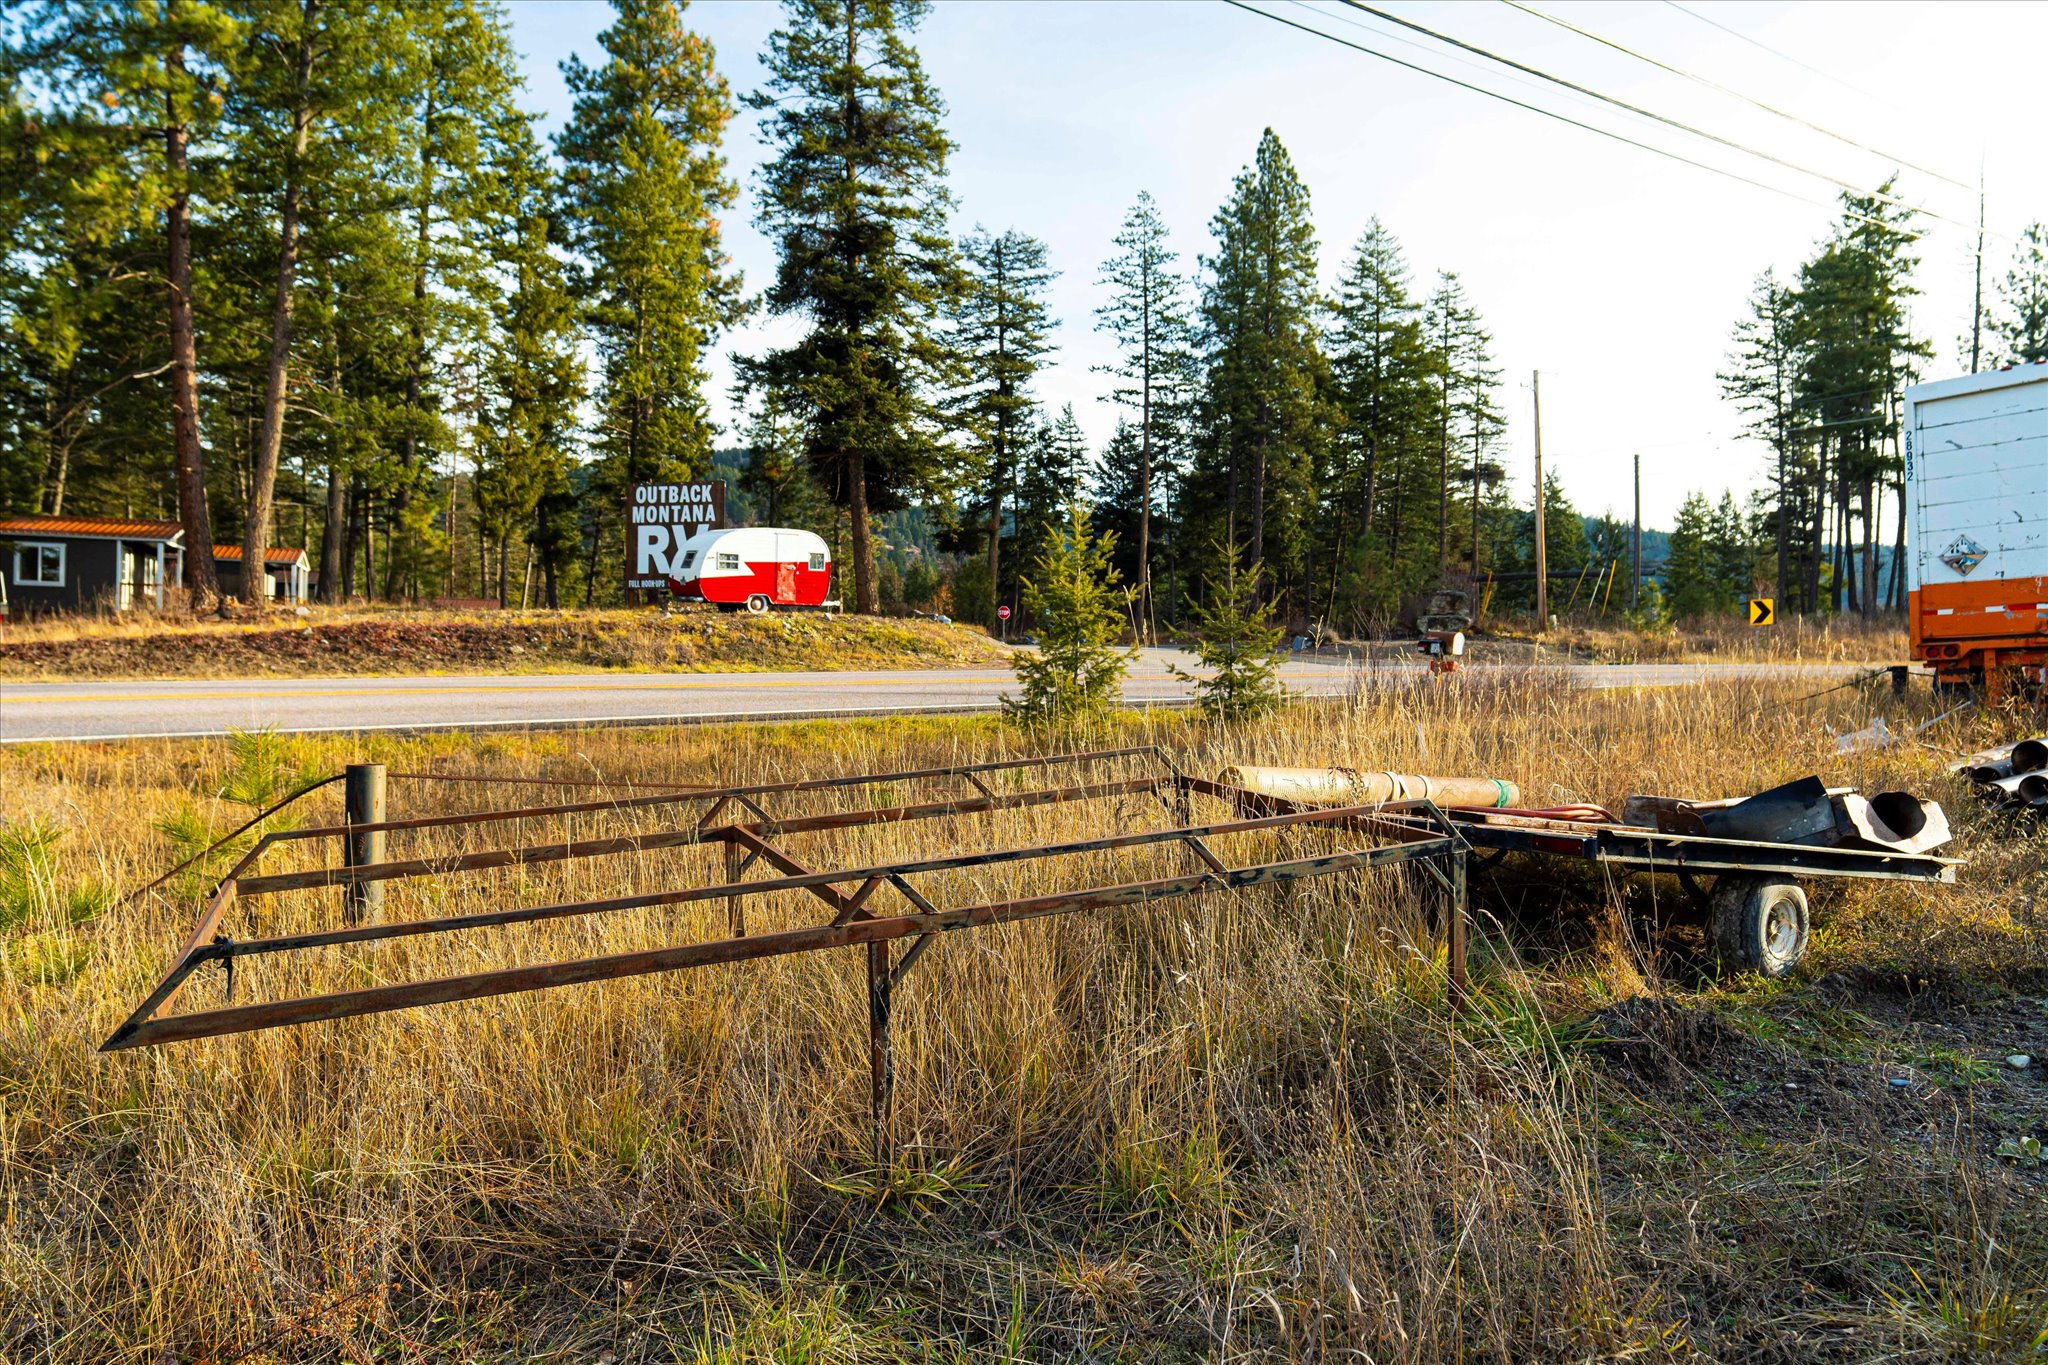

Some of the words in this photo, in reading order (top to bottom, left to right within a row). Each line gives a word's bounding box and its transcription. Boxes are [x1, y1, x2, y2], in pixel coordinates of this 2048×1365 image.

[1906, 430, 1914, 481] 28932
[635, 484, 712, 504] OUTBACK
[632, 504, 716, 523] MONTANA
[628, 579, 640, 588] FULL
